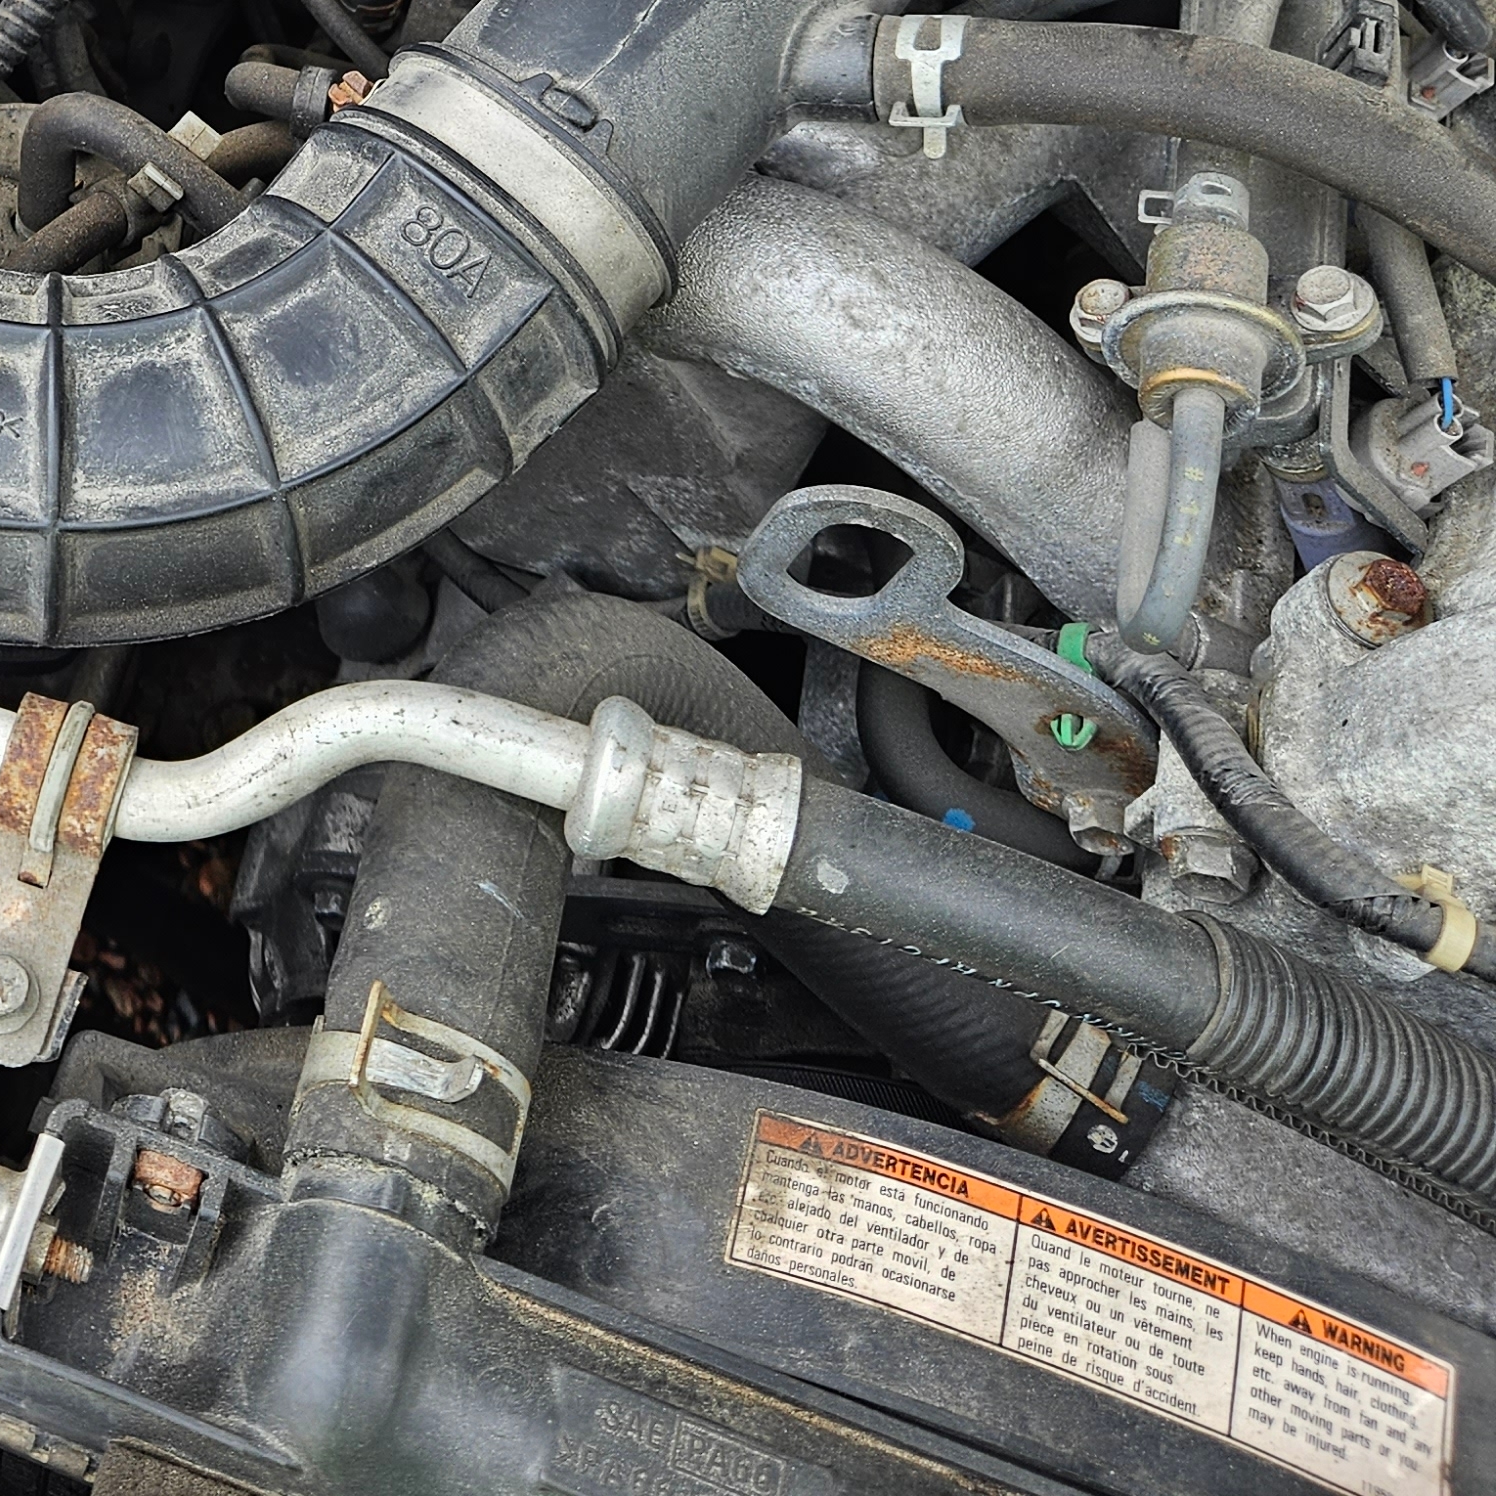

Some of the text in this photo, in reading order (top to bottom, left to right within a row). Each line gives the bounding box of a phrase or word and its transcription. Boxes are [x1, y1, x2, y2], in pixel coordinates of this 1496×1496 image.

[395, 196, 502, 299] 80A
[832, 1141, 969, 1198] ADVERTENCIA
[834, 1171, 871, 1190] motor
[915, 1193, 988, 1231] funcionando
[760, 1165, 996, 1255] mantenga las manos, cabellos, ropa
[787, 1198, 831, 1220] alejado
[839, 1212, 858, 1228] del
[867, 1222, 930, 1250] ventilador
[938, 1246, 946, 1260] y
[954, 1249, 968, 1265] de
[767, 1234, 823, 1258] contrario
[882, 1268, 956, 1302] ocasionarse
[789, 1260, 857, 1289] personales.
[817, 1228, 844, 1245] otra
[851, 1238, 884, 1256] parte
[941, 1265, 956, 1281] de
[1031, 1234, 1220, 1319] Quand le moteur tourne, ne
[1065, 1219, 1230, 1295] AVERTISSEMENT
[1025, 1275, 1192, 1350] cheveux ou un vêtement
[1028, 1257, 1223, 1341] pas approcher les mains, les
[1022, 1294, 1205, 1376] du ventilateur ou de toute
[1063, 1332, 1078, 1346] en
[1087, 1341, 1137, 1370] rotation
[1146, 1365, 1174, 1385] sous
[1256, 1321, 1292, 1349] When
[1300, 1345, 1339, 1370] engine
[1347, 1361, 1357, 1378] is
[1322, 1320, 1404, 1372] WARNING
[1017, 1337, 1197, 1415] peine de risque d'accident.
[1254, 1342, 1283, 1367] keep
[1291, 1358, 1327, 1388] hands,
[1336, 1379, 1361, 1403] hair,
[598, 1400, 669, 1451] SAE
[1248, 1407, 1348, 1461] may be injured.
[1250, 1387, 1282, 1408] other
[1290, 1404, 1333, 1436] moving
[1341, 1428, 1371, 1449] parts
[1379, 1445, 1390, 1457] or
[1253, 1366, 1432, 1457] etc. away from fan and any
